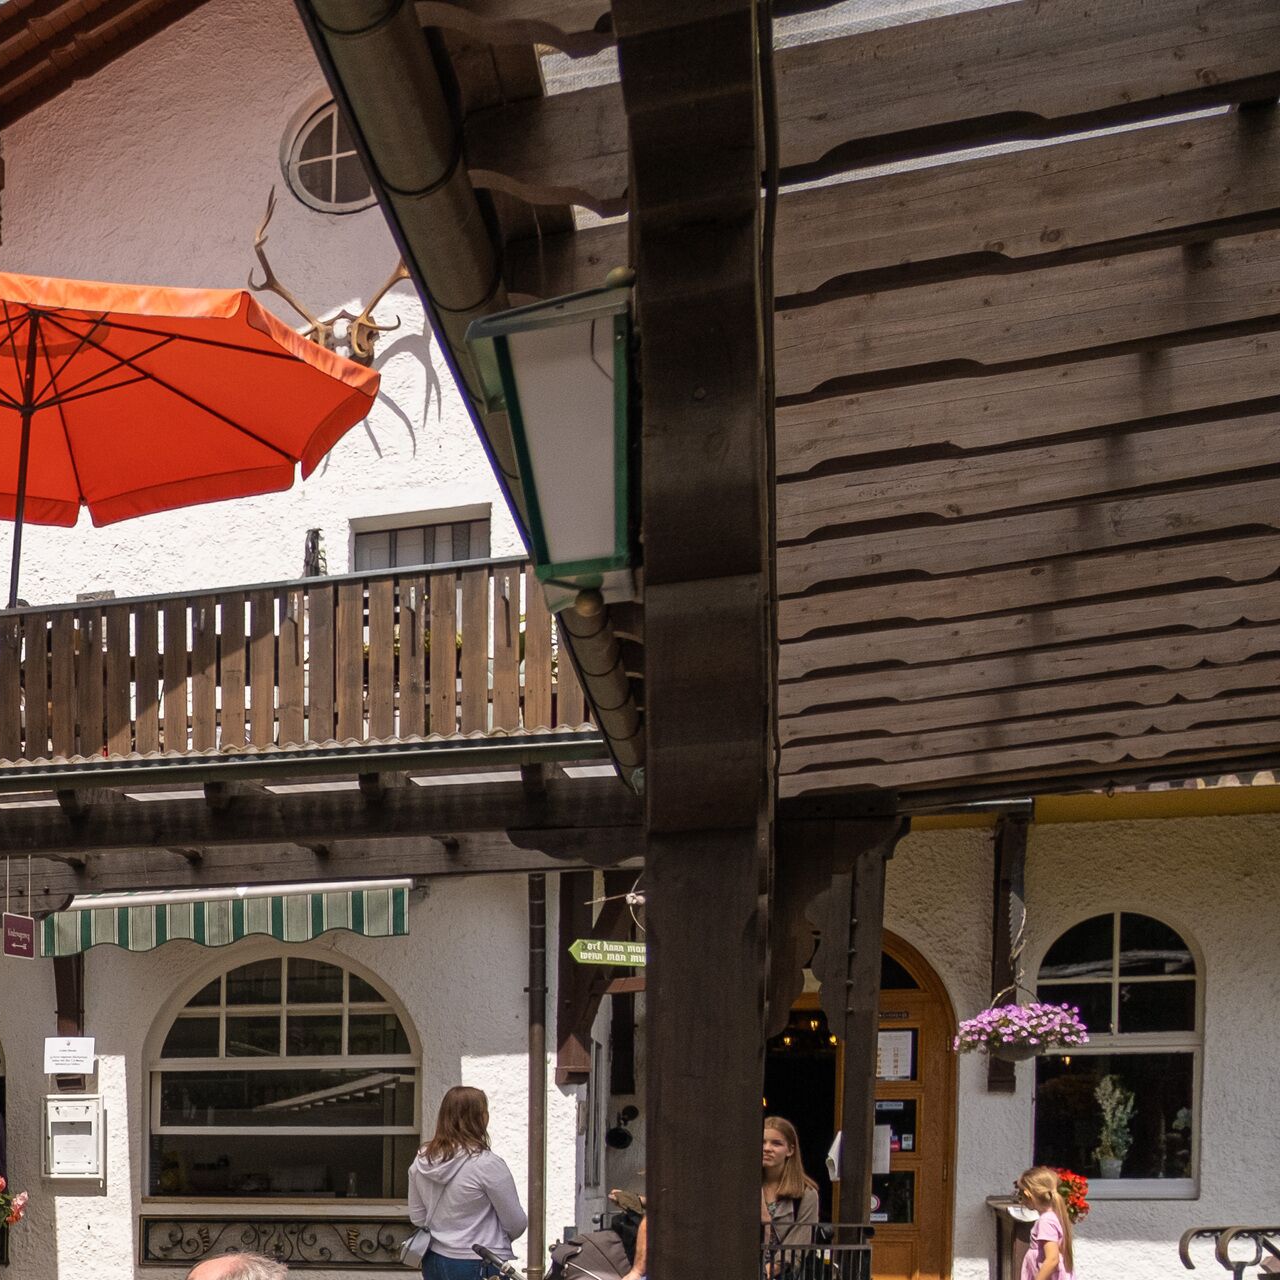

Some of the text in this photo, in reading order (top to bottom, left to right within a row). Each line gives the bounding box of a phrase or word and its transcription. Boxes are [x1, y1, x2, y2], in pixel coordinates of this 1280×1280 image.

[580, 951, 646, 964] wenn man mu
